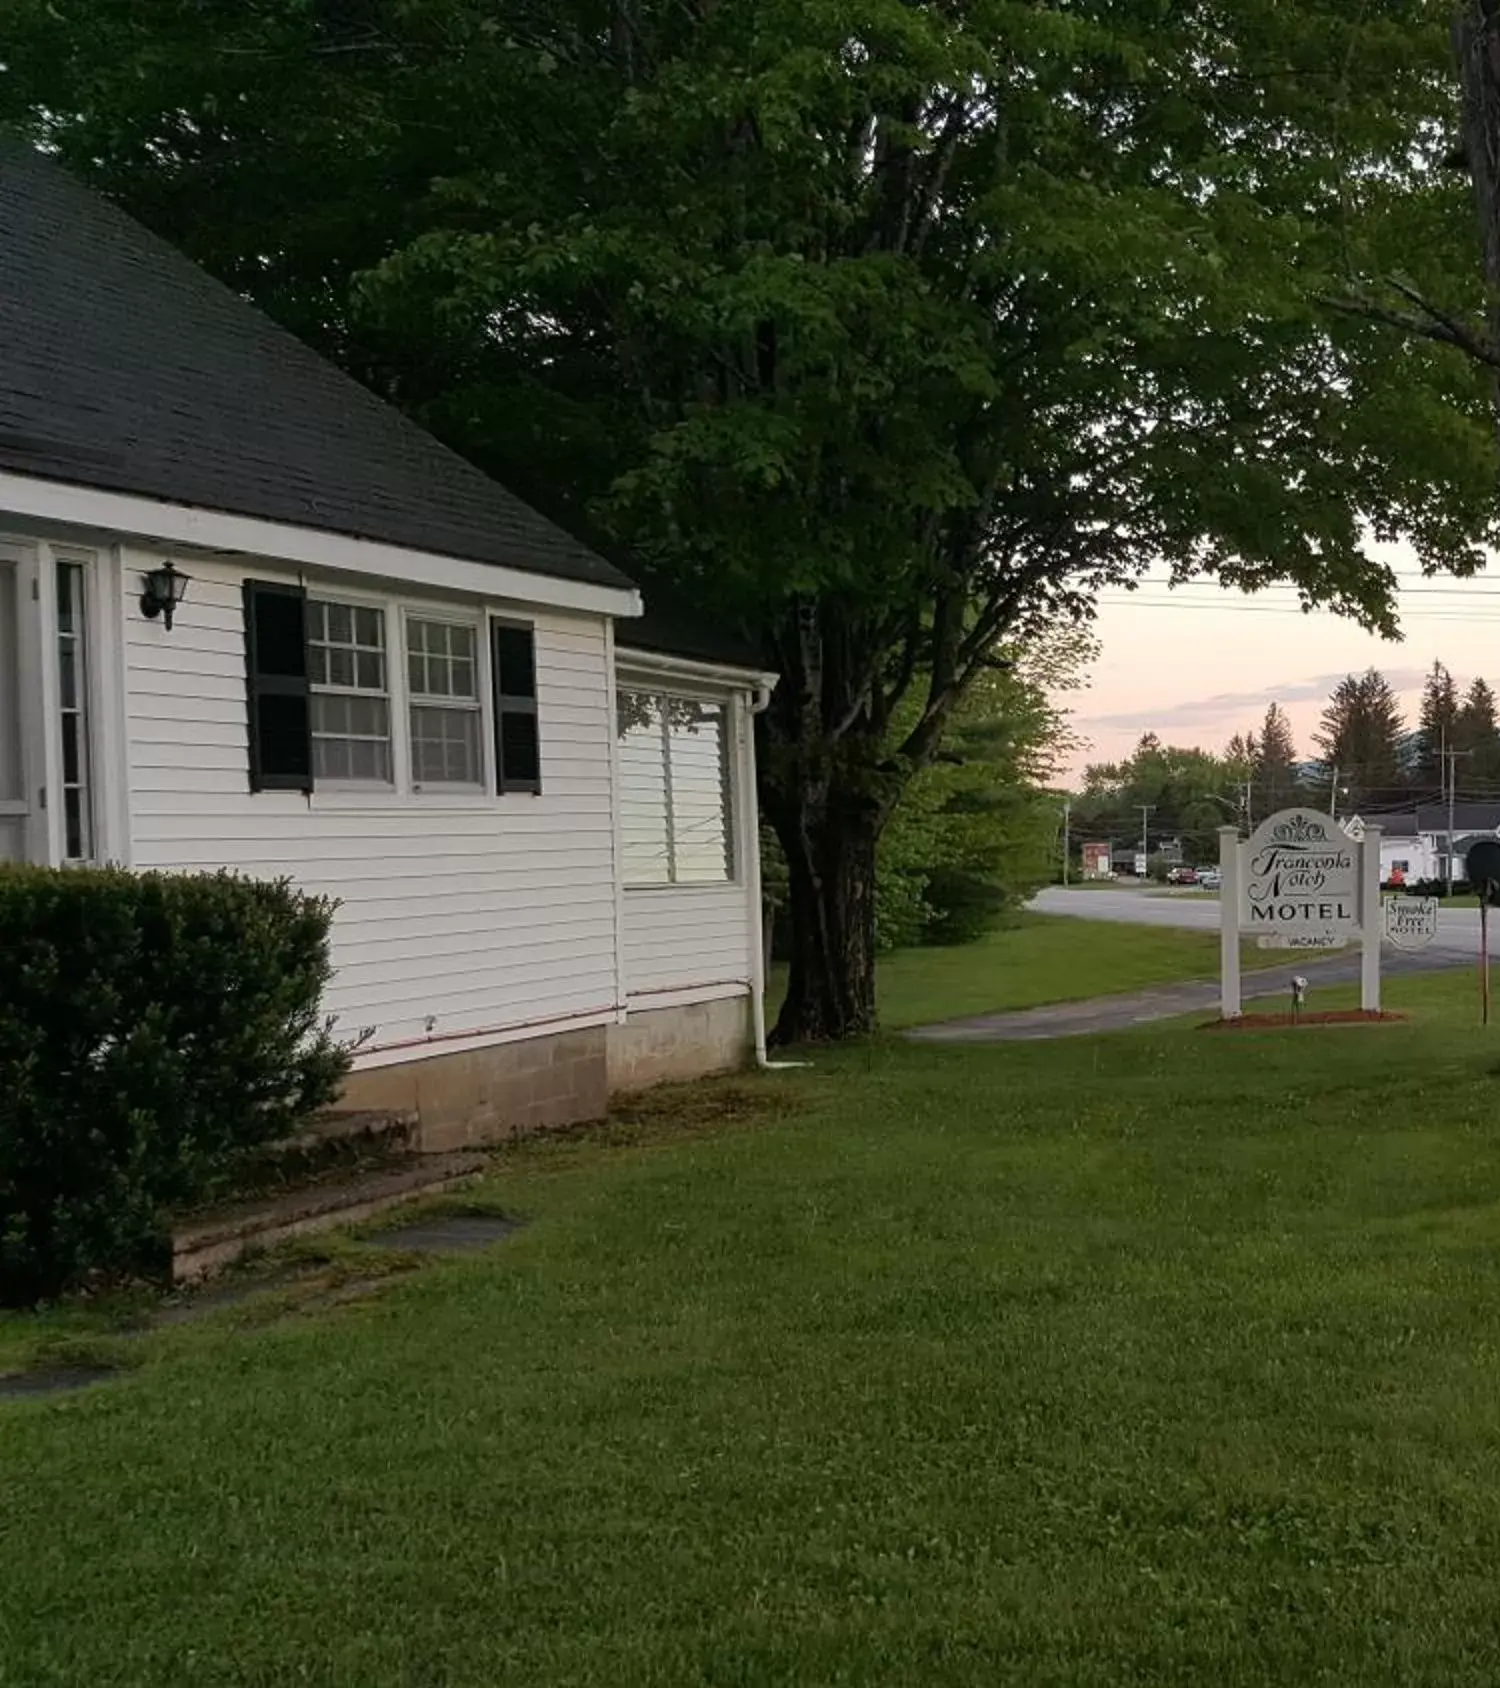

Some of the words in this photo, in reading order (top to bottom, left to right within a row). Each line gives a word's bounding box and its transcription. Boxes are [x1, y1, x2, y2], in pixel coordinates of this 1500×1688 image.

[1251, 844, 1351, 877] Franconia
[1248, 869, 1325, 901] Notch
[1251, 903, 1351, 920] MOTEL
[1390, 901, 1432, 916] Smoke
[1397, 915, 1425, 926] Free
[1390, 927, 1432, 935] MOTEL
[1287, 936, 1335, 947] VACANCY
